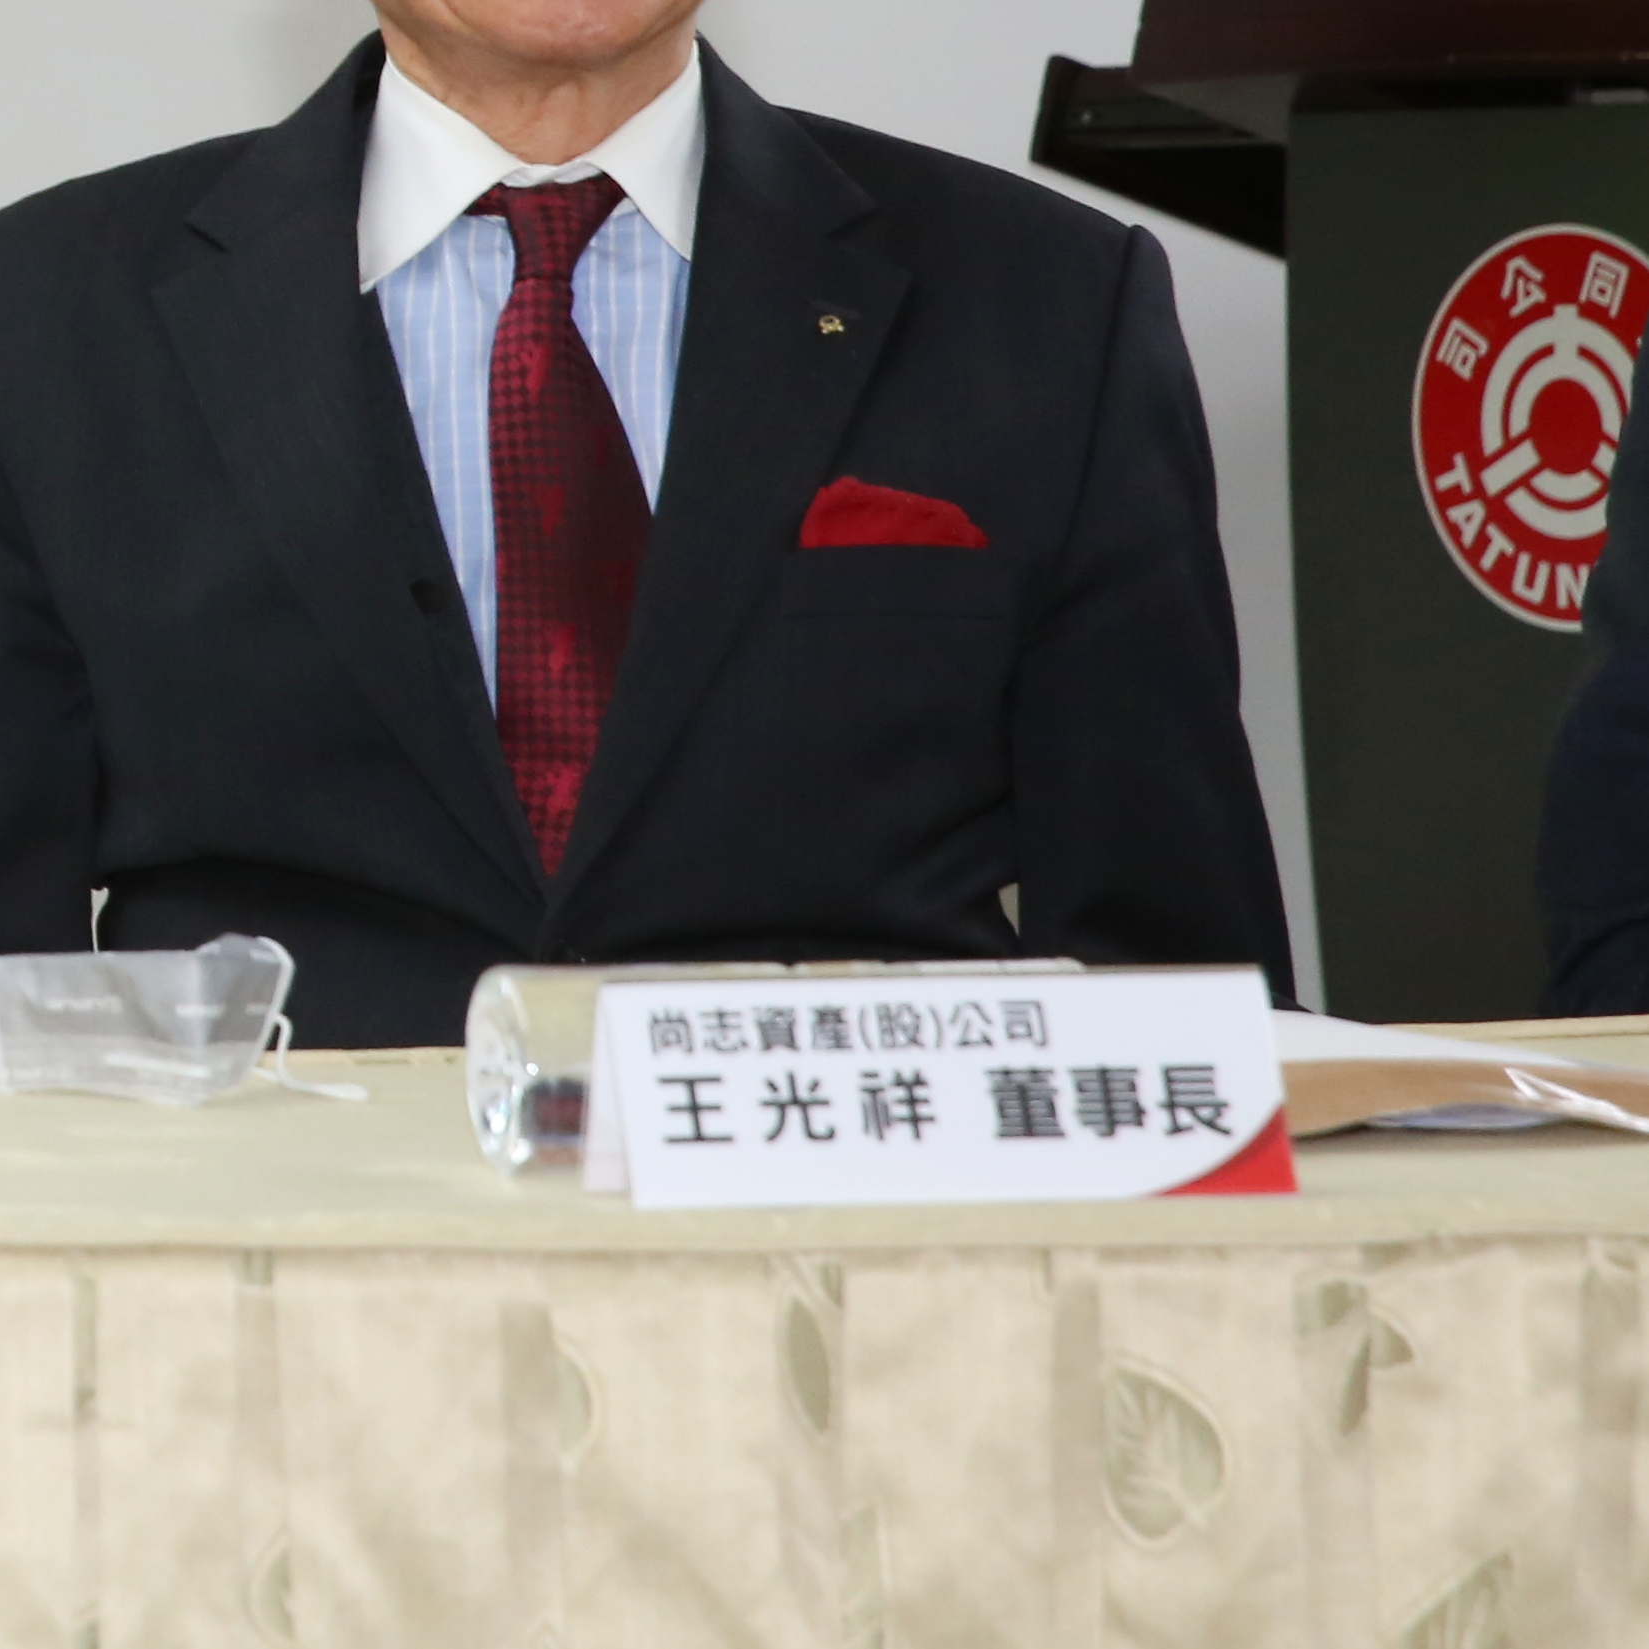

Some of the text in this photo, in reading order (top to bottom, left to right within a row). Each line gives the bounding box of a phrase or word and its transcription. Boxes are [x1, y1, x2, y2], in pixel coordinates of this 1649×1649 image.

[1436, 250, 1643, 382] 同公司
[1434, 452, 1595, 611] TATUN
[648, 999, 1049, 1054] 尚志資產(股)公司
[657, 1063, 1234, 1144] 王光祥 董事長
